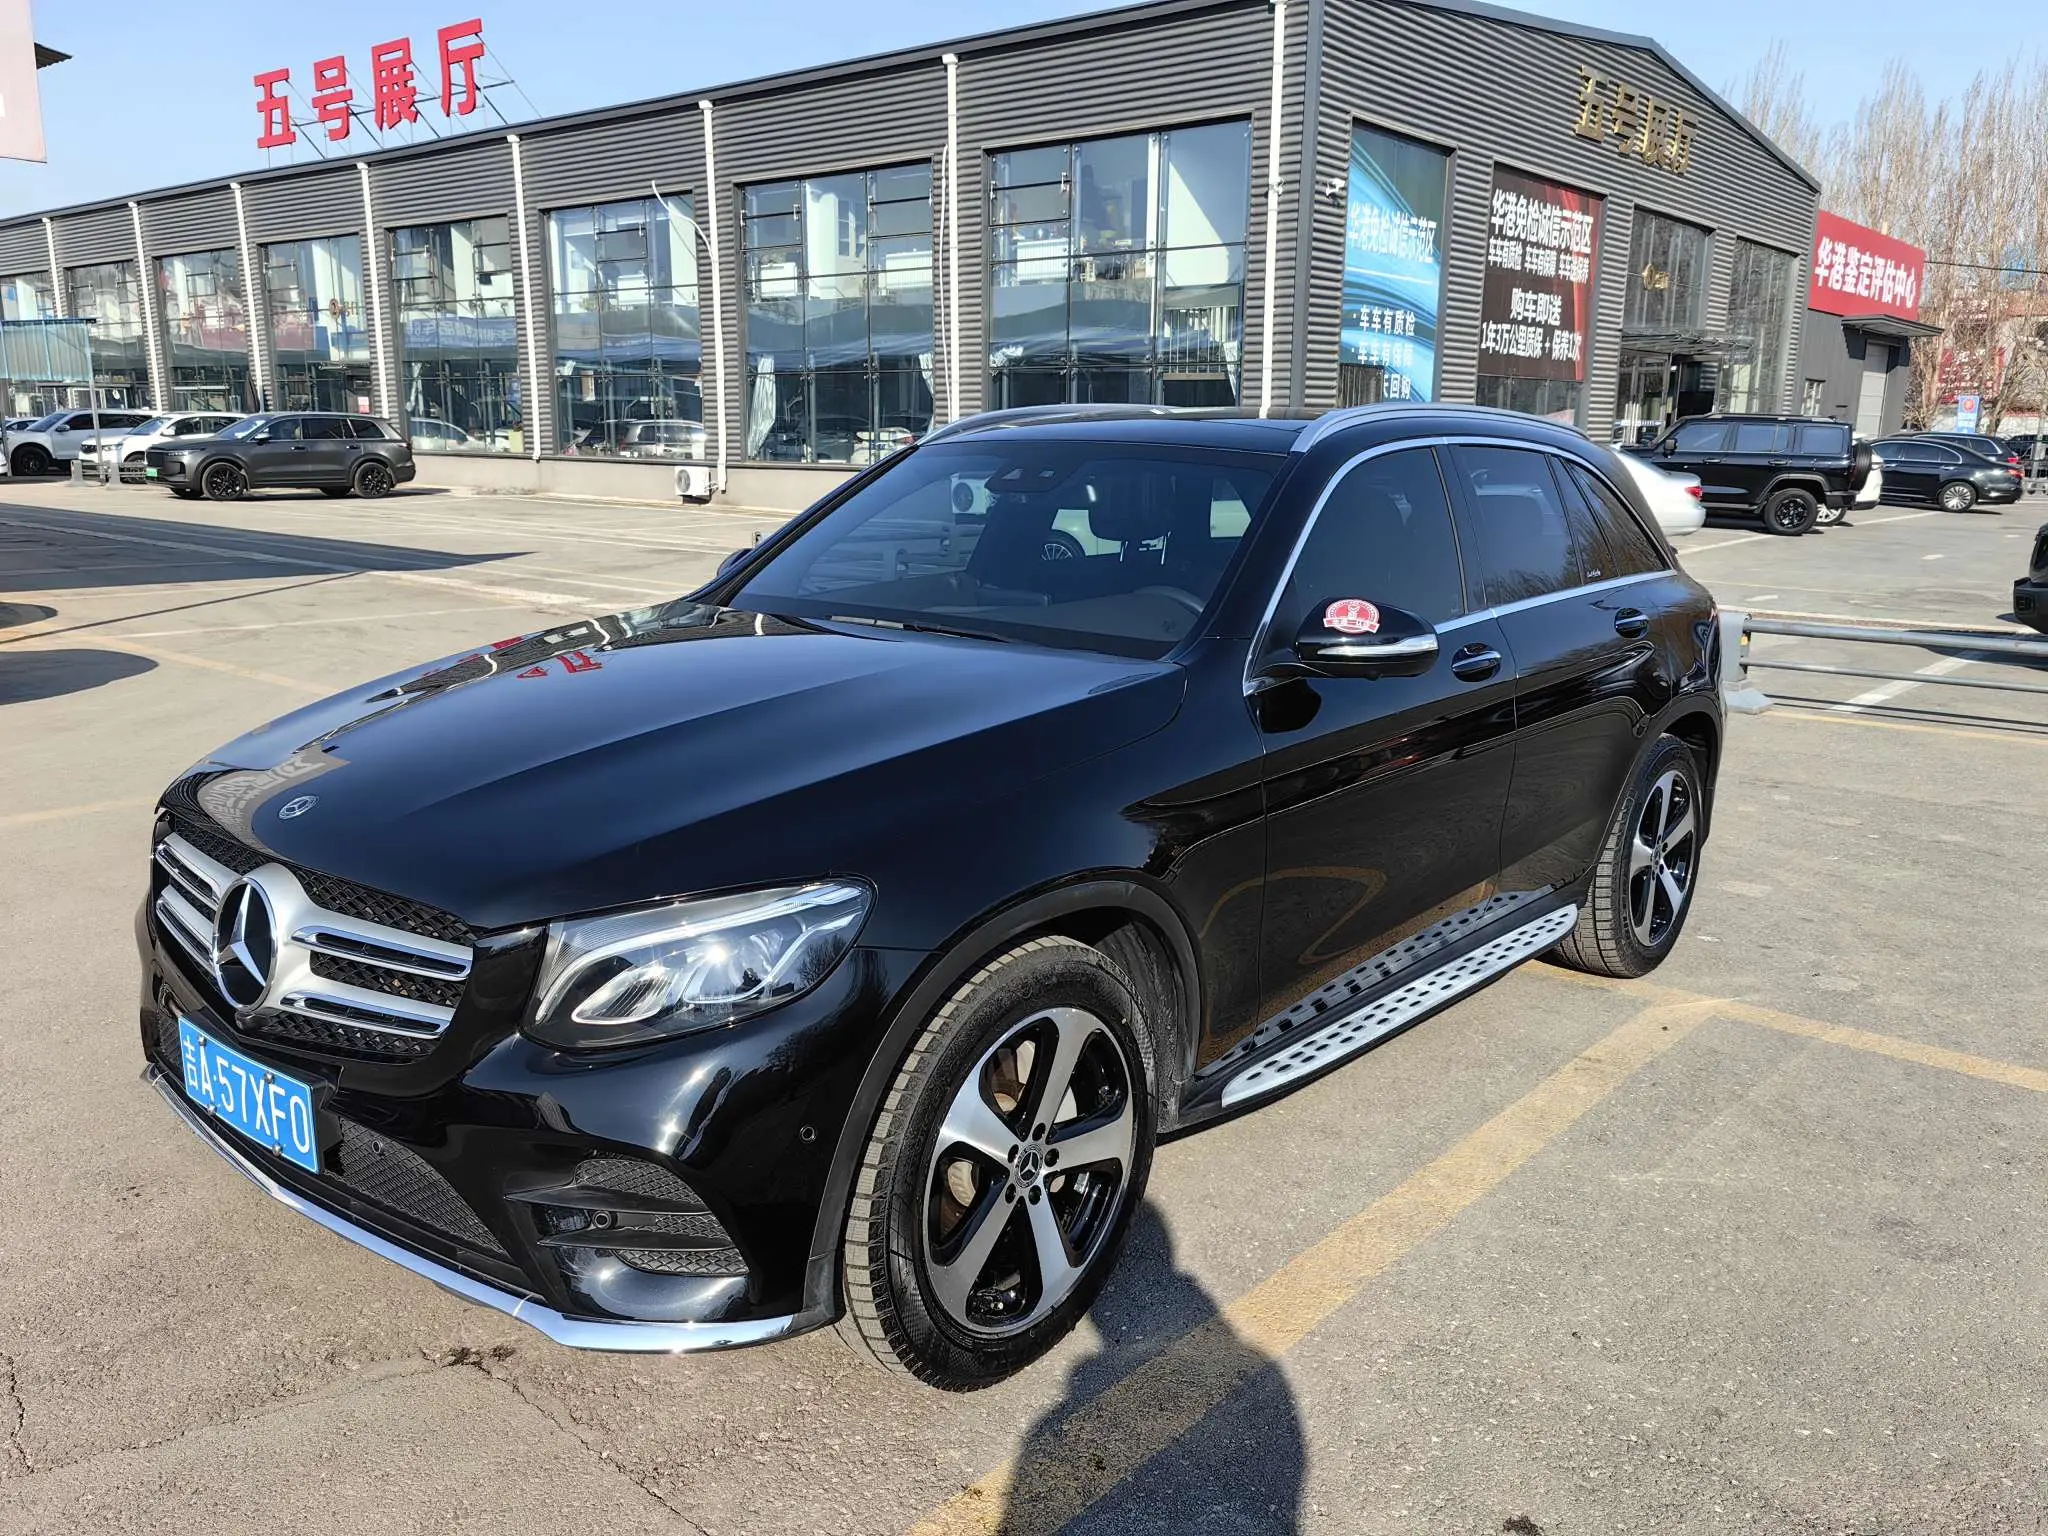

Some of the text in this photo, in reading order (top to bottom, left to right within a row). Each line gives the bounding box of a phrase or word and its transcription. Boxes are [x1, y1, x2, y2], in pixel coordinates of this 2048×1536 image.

[253, 18, 485, 149] 五号展厅
[1575, 64, 1698, 176] 五号展厅
[1348, 200, 1437, 263] 华港免检诚信示范区
[1491, 187, 1594, 254] 华港免检诚信示范区
[1488, 236, 1523, 271] 车车有质检
[1814, 236, 1917, 309] 华港鉴定评估中心
[1359, 304, 1415, 336] 车车有质检
[1510, 287, 1562, 326] 购车即送
[1481, 320, 1544, 359] 1年3万公里质保
[1551, 329, 1582, 361] 保养1次
